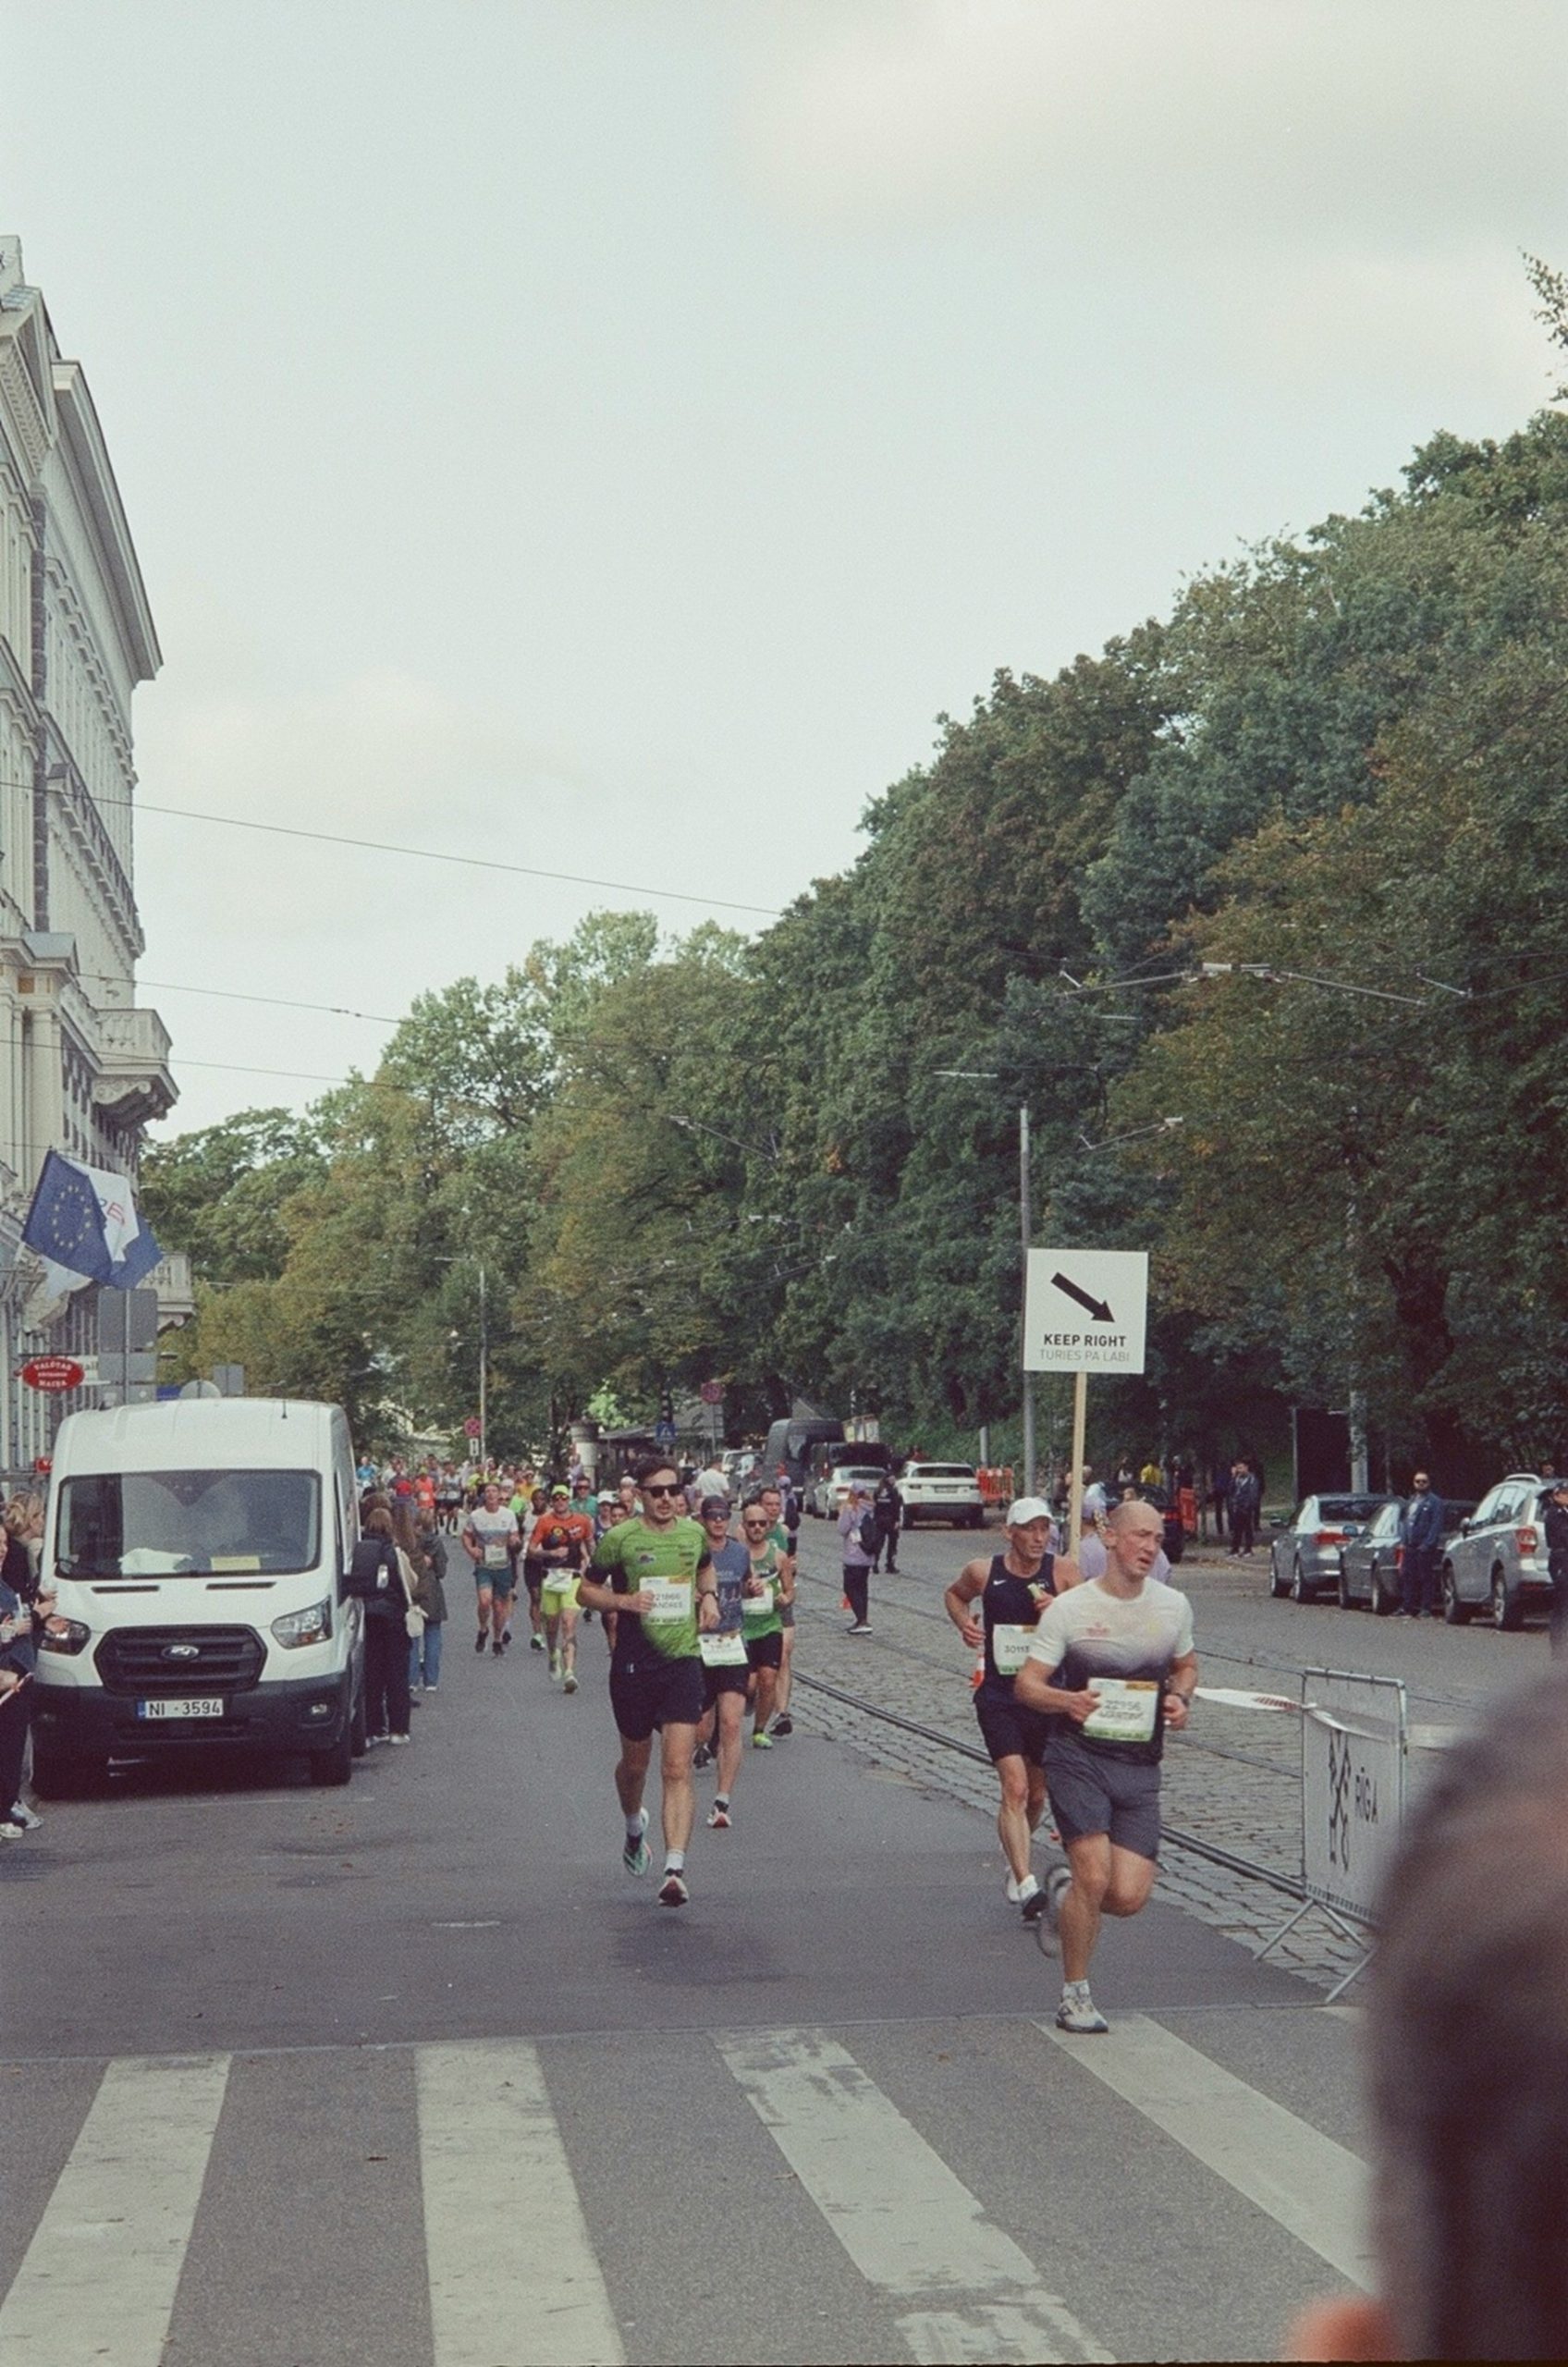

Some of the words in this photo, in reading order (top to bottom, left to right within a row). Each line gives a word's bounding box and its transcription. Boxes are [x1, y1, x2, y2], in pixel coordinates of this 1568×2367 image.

[1044, 1334, 1080, 1345] KEEP
[1084, 1335, 1126, 1347] RIGHT
[1040, 1350, 1081, 1361] TURIES
[1084, 1351, 1099, 1361] PA
[1103, 1352, 1130, 1362] LABI
